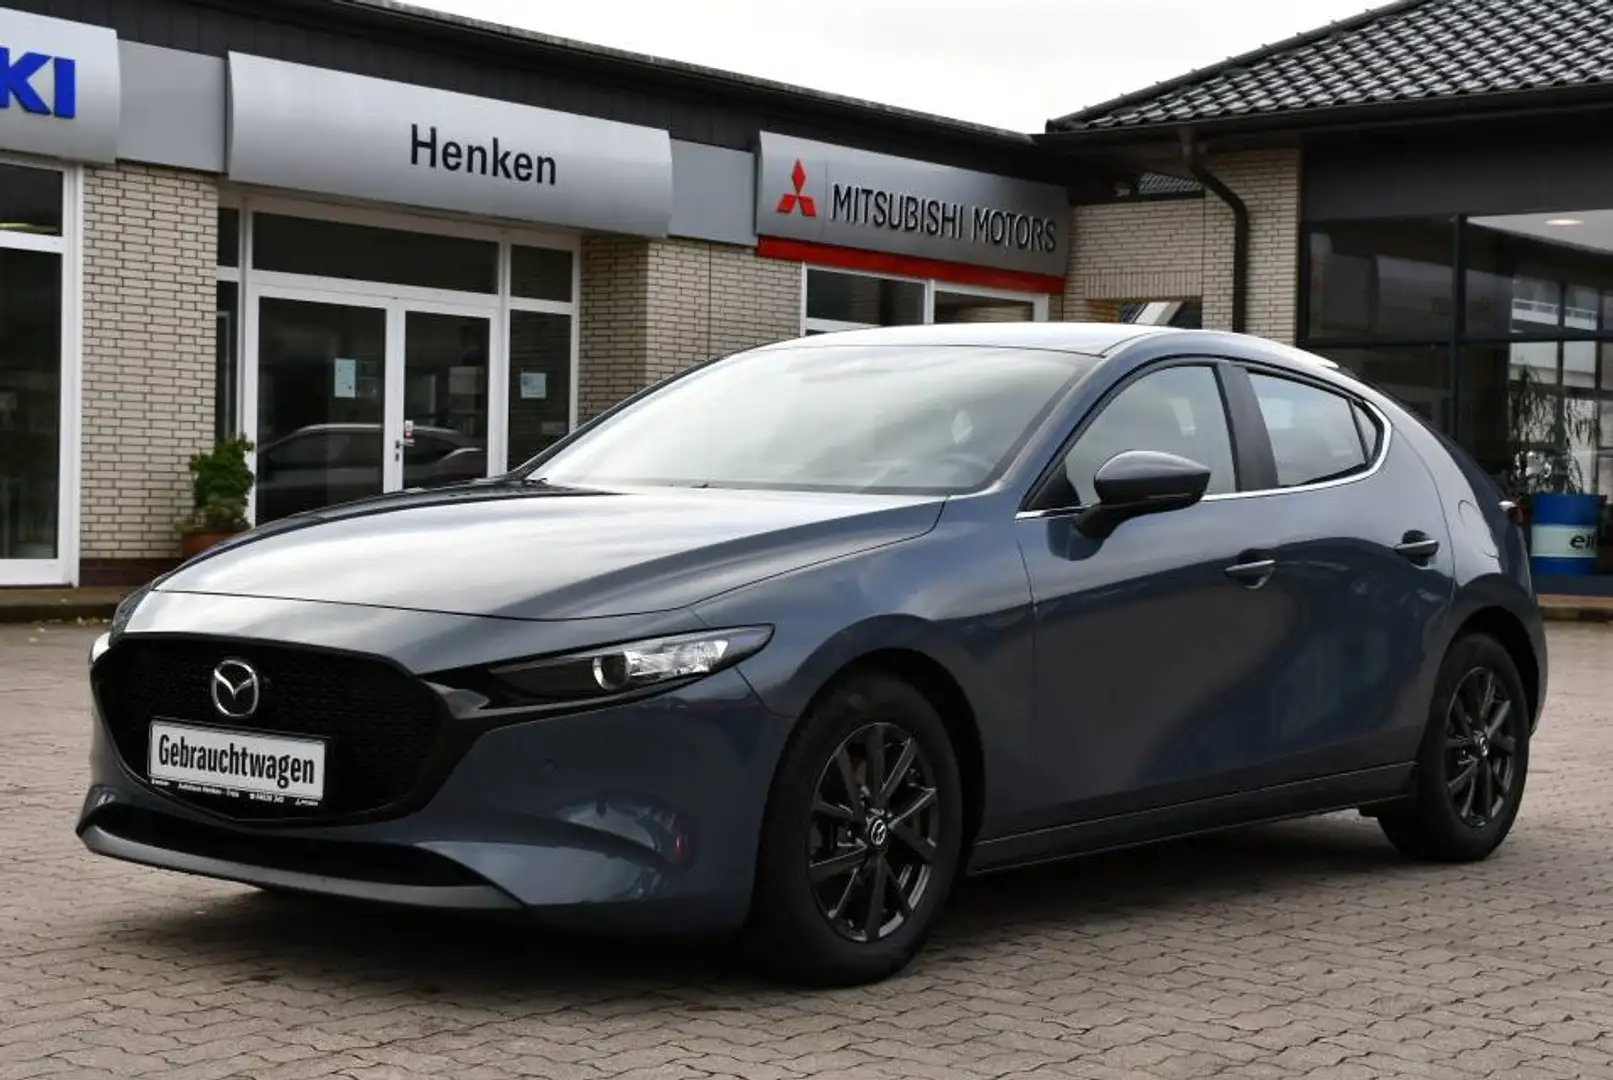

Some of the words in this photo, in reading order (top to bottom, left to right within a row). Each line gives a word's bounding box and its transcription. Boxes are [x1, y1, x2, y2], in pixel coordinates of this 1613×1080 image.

[0, 46, 76, 119] KI
[411, 123, 556, 186] Henken
[830, 183, 964, 240] MITSUBISHI
[971, 206, 1056, 253] MOTORS
[158, 734, 315, 788] Gebrauchtwagen
